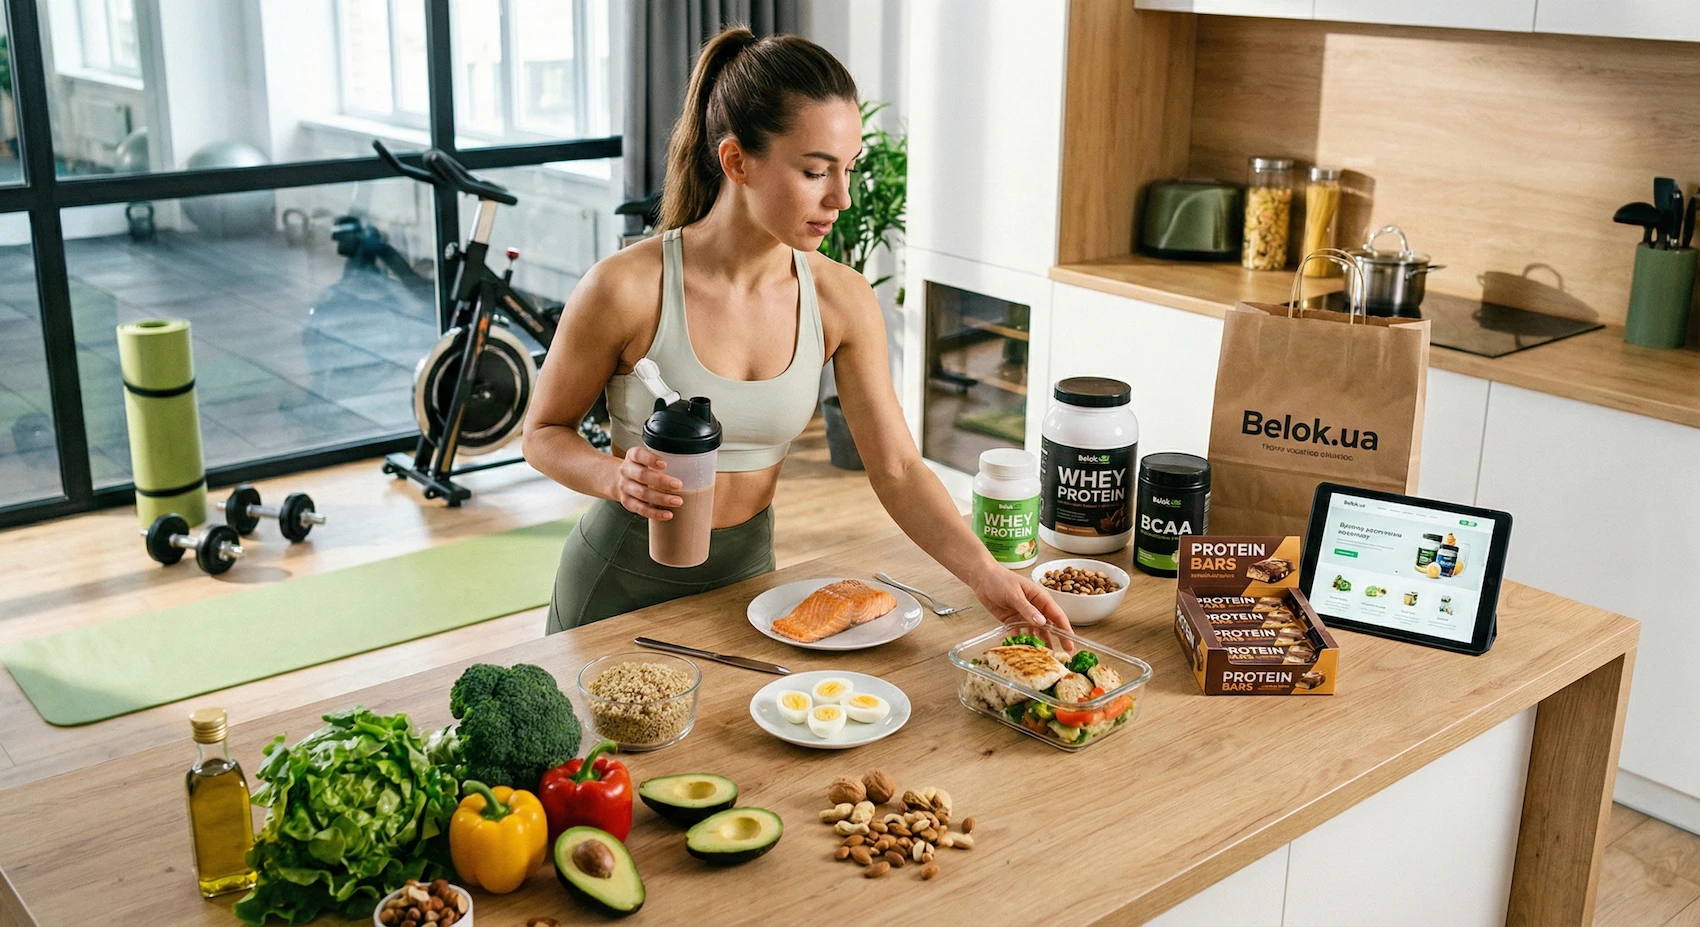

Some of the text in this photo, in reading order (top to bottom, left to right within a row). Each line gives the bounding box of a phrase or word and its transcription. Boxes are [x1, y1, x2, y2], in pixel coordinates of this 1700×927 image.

[1242, 410, 1379, 451] Belok.ua
[1058, 466, 1127, 488] WHEY
[1057, 486, 1125, 502] PROTEIN
[984, 511, 1034, 527] WHEY
[1141, 513, 1193, 535] BCAA
[984, 525, 1033, 538] PROTEIN
[1191, 543, 1265, 556] PROTEIN
[1190, 557, 1237, 571] BARS
[1226, 646, 1285, 655] ROTEIN
[1222, 671, 1293, 683] PROTEIN
[1221, 682, 1254, 692] BARS
